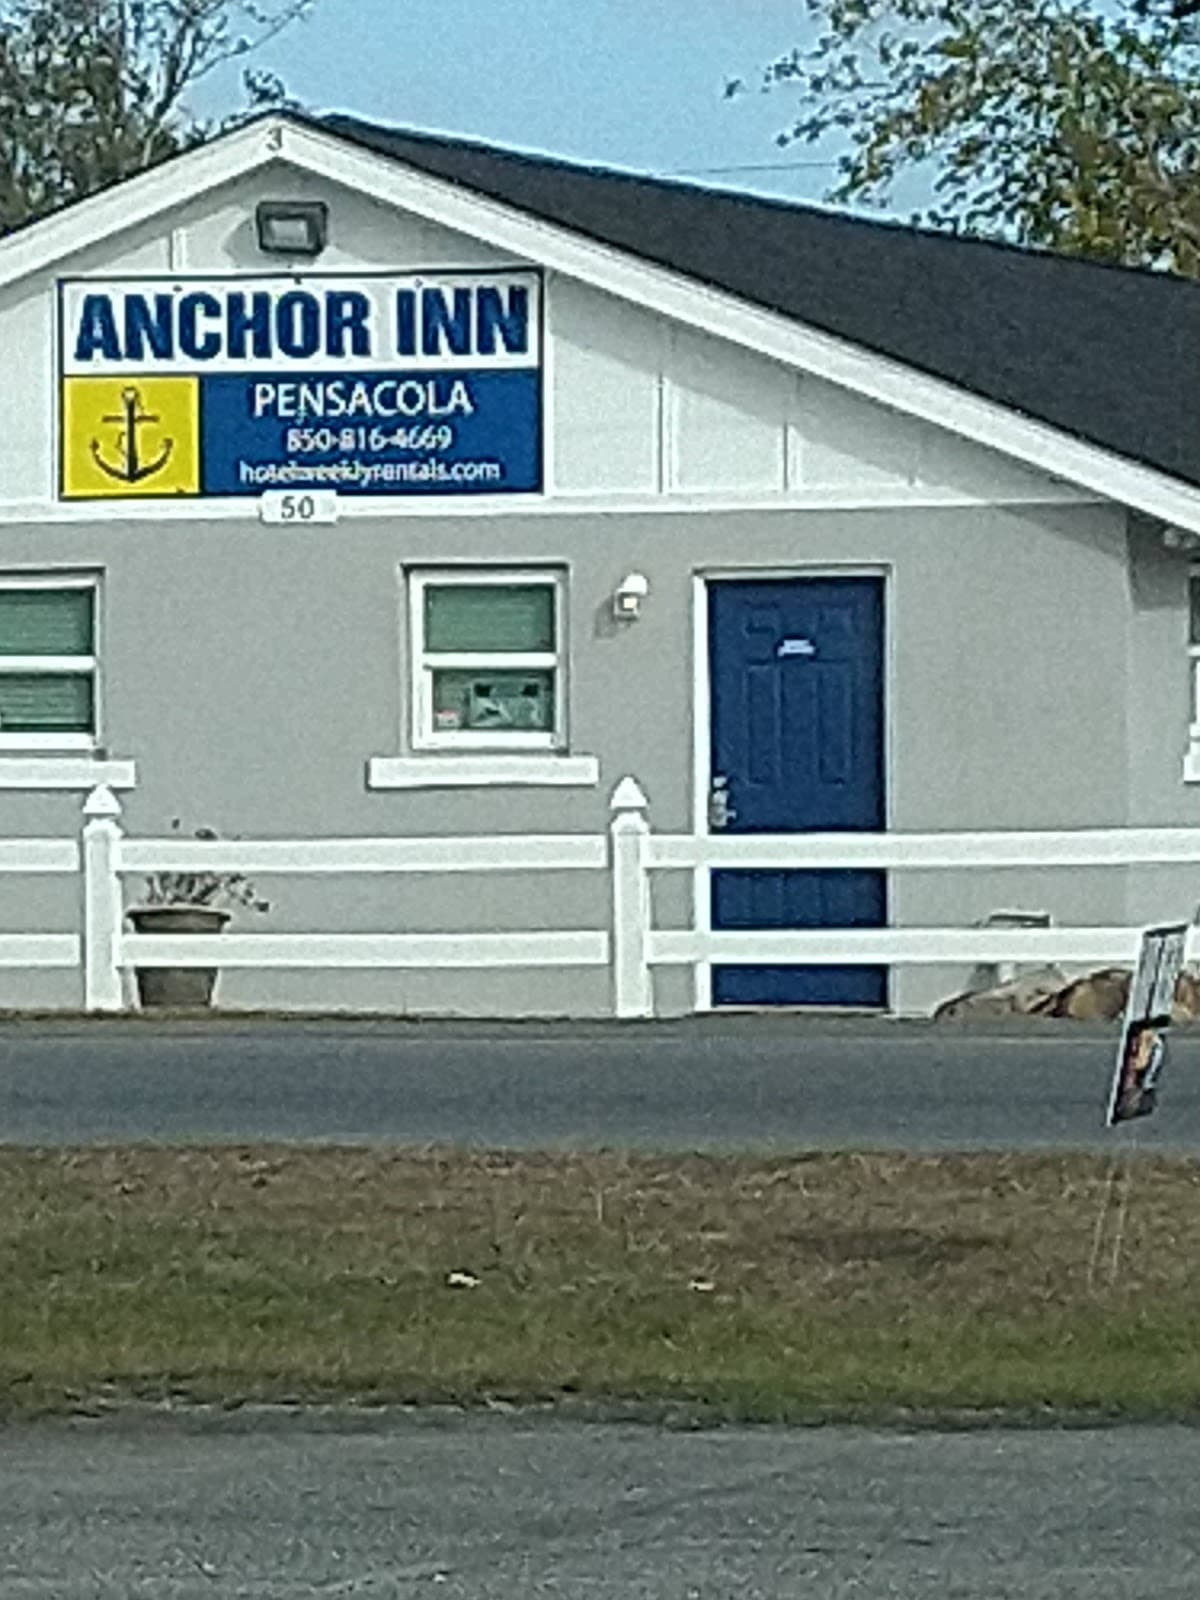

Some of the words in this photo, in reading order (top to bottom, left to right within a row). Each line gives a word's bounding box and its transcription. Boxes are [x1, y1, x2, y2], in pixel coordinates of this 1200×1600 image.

[74, 291, 371, 361] ANCHOR
[397, 285, 528, 356] INN
[253, 380, 475, 418] PENSACOLA
[286, 425, 452, 453] 850-816-4669
[281, 495, 315, 519] 50
